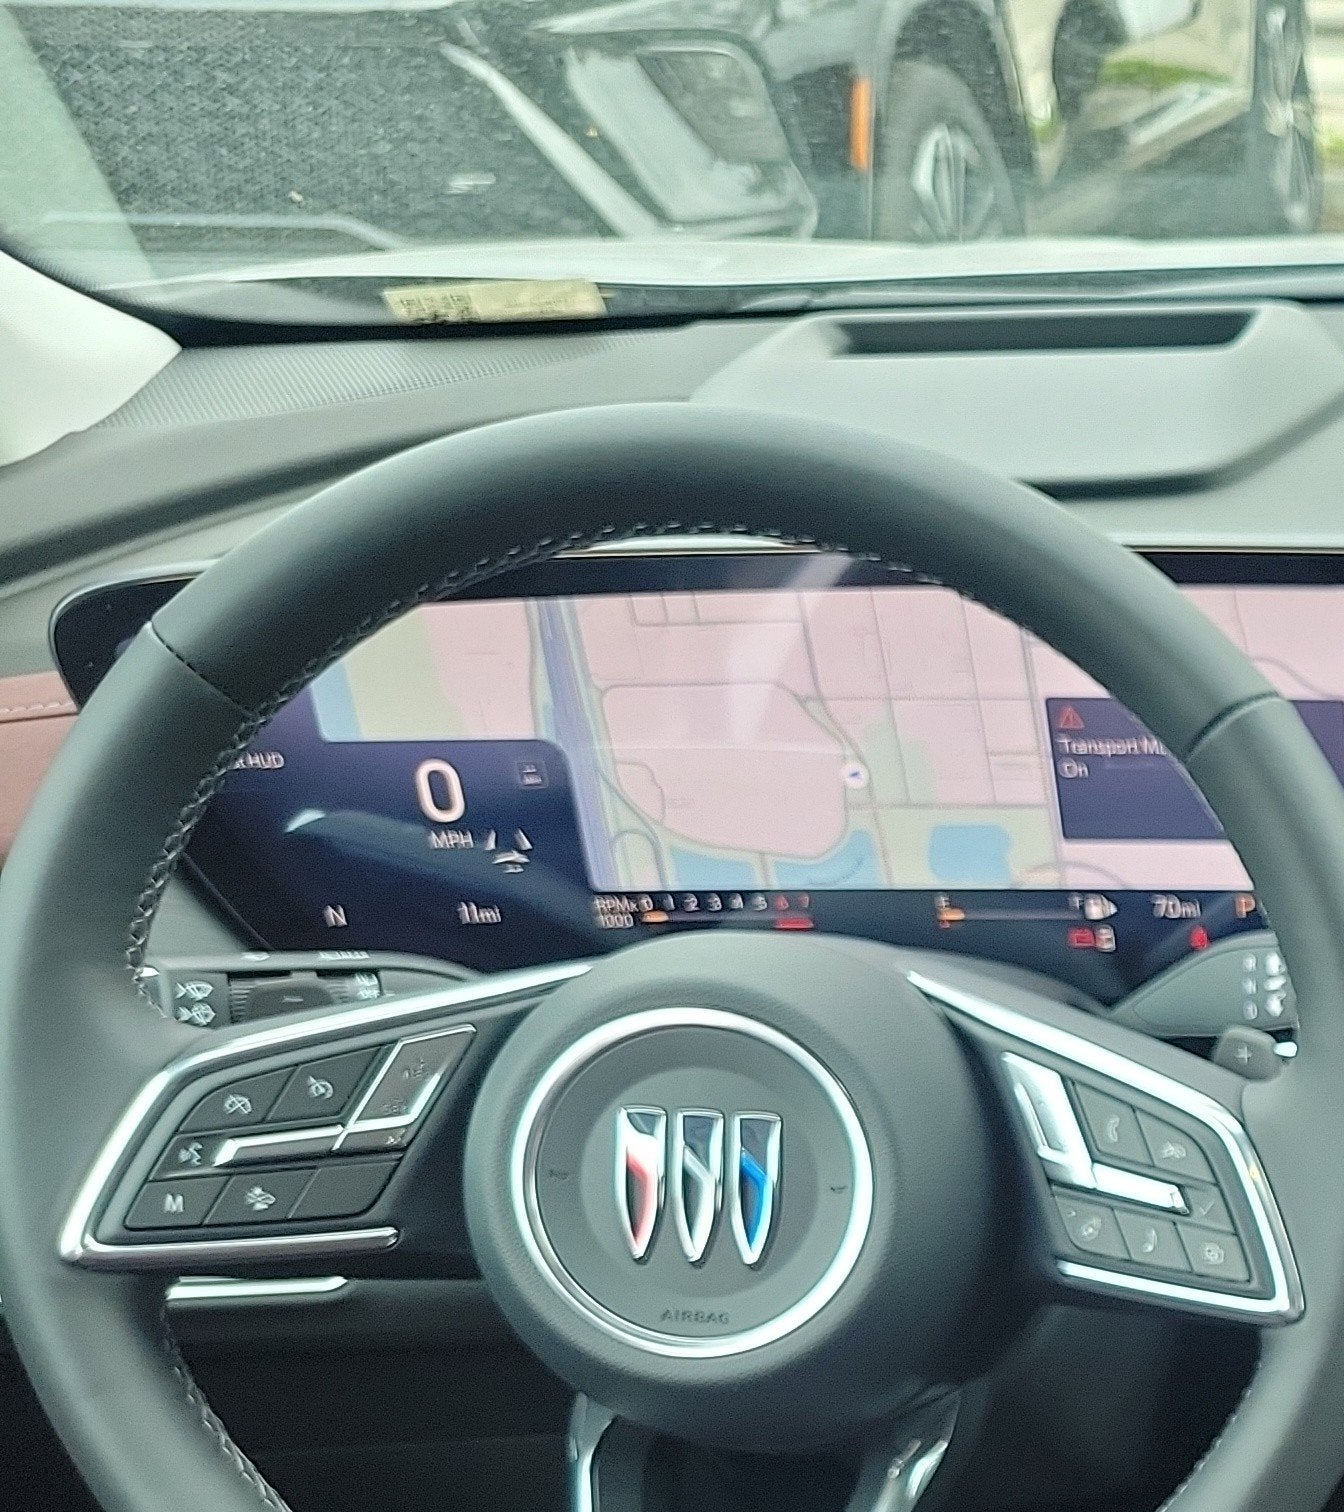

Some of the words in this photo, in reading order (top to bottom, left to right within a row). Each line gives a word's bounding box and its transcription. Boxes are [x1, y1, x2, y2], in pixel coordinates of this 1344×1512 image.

[1056, 734, 1138, 758] Transport
[247, 751, 285, 770] HUD
[1057, 757, 1088, 779] On
[414, 757, 467, 824] 0
[429, 829, 475, 850] MPH
[323, 904, 348, 927] N
[600, 911, 634, 929] 1000
[660, 1309, 730, 1325] AIRBAG
